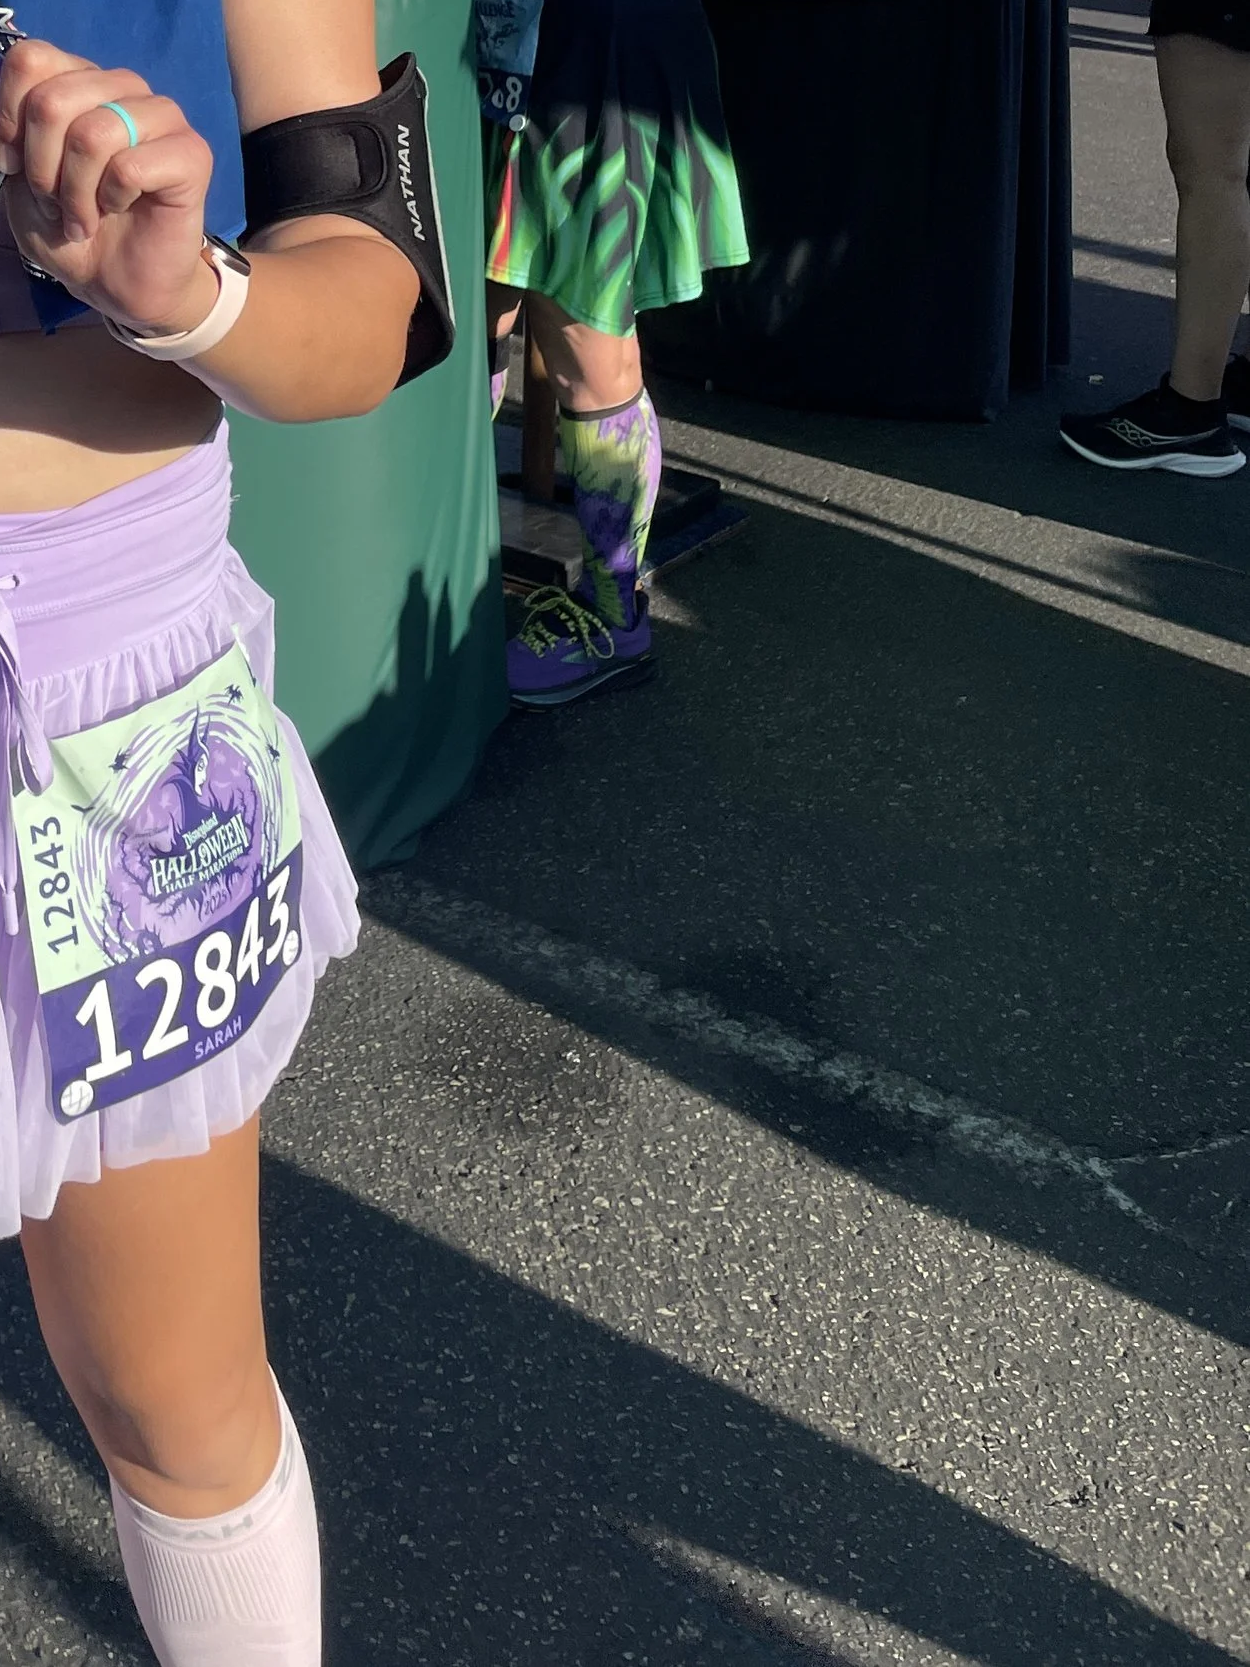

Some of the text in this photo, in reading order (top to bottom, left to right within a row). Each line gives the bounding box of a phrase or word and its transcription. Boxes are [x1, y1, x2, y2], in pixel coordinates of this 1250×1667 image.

[397, 124, 426, 241] NATHAN
[30, 816, 79, 954] 12843
[150, 812, 249, 897] HALLOWEEN
[164, 845, 244, 894] HALF MARATHON
[75, 865, 291, 1083] 12843
[194, 1016, 243, 1061] SARAH
